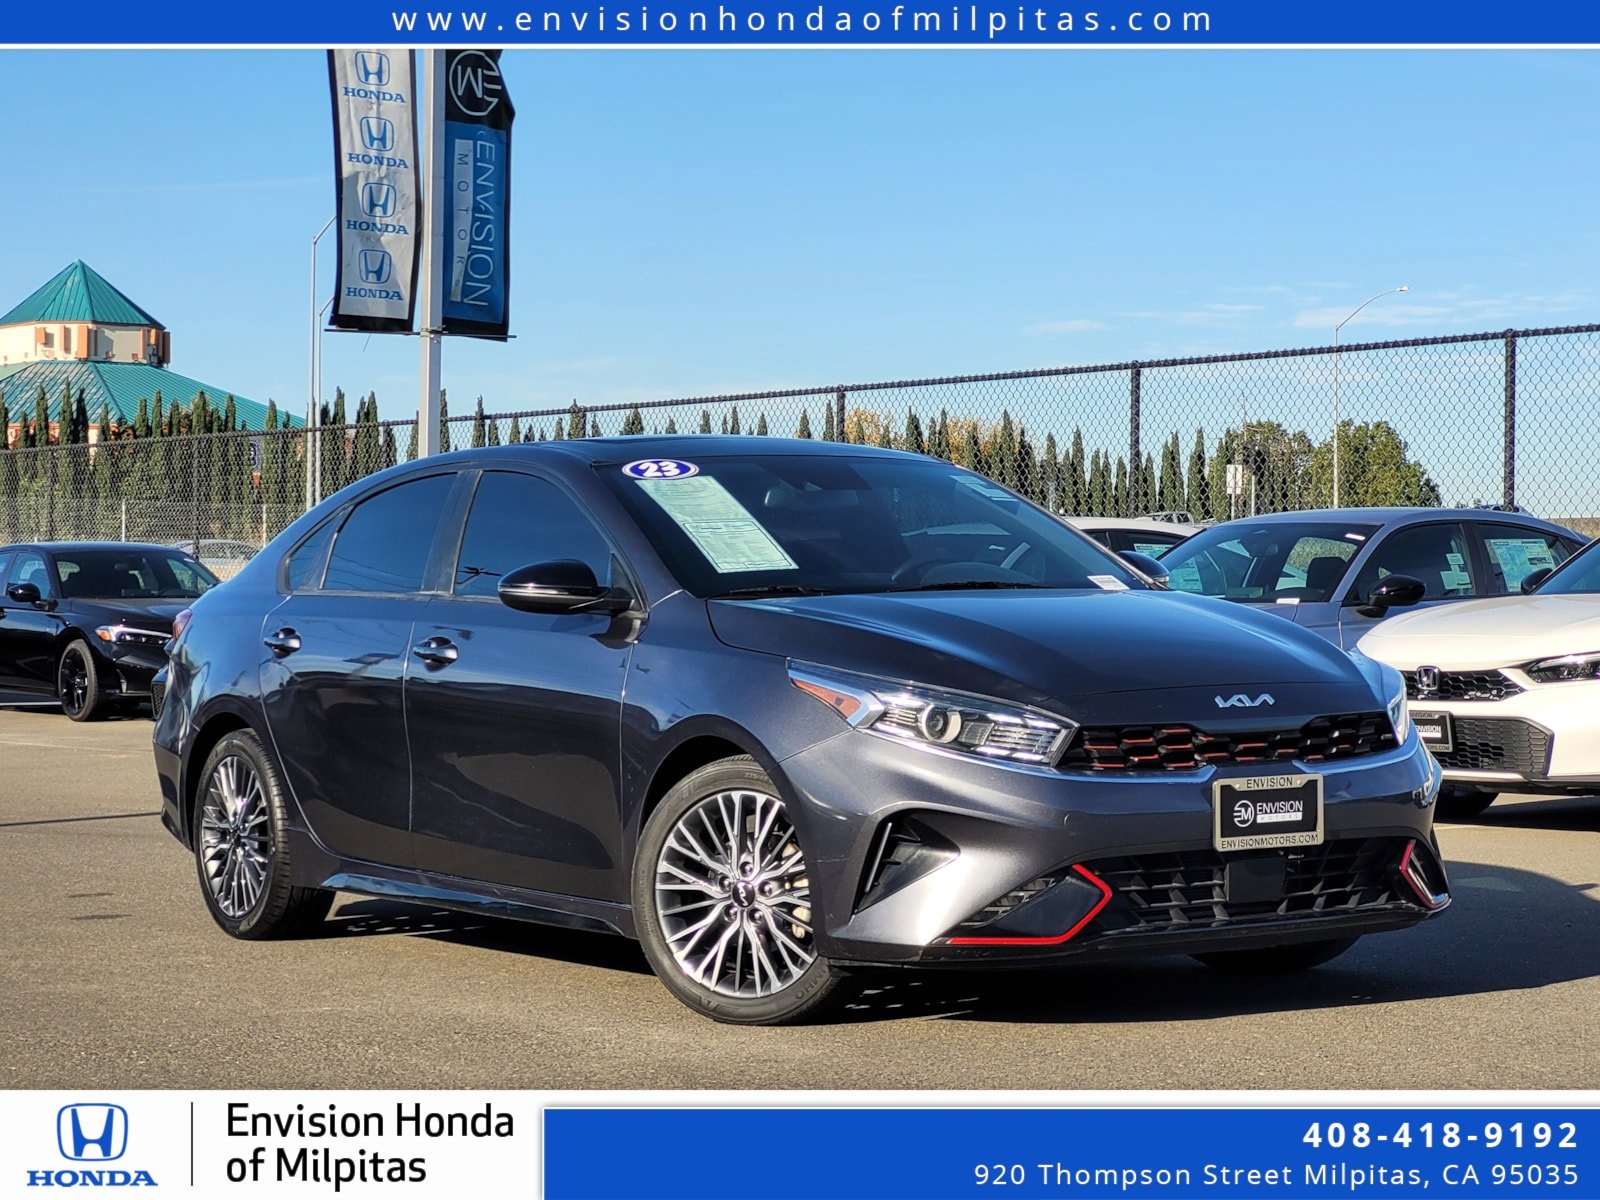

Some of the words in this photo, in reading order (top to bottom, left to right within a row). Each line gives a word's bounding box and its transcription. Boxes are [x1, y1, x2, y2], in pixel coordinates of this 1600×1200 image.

[342, 87, 406, 103] HONDA
[347, 153, 408, 169] HONDA
[345, 219, 408, 235] HONDA
[463, 140, 495, 306] ENVISION
[345, 286, 404, 301] HONDA
[638, 462, 682, 477] 23
[1246, 777, 1293, 789] ENVISION
[1256, 800, 1303, 815] ENVISION
[1221, 834, 1319, 849] ENVISIONMOTORS.COM
